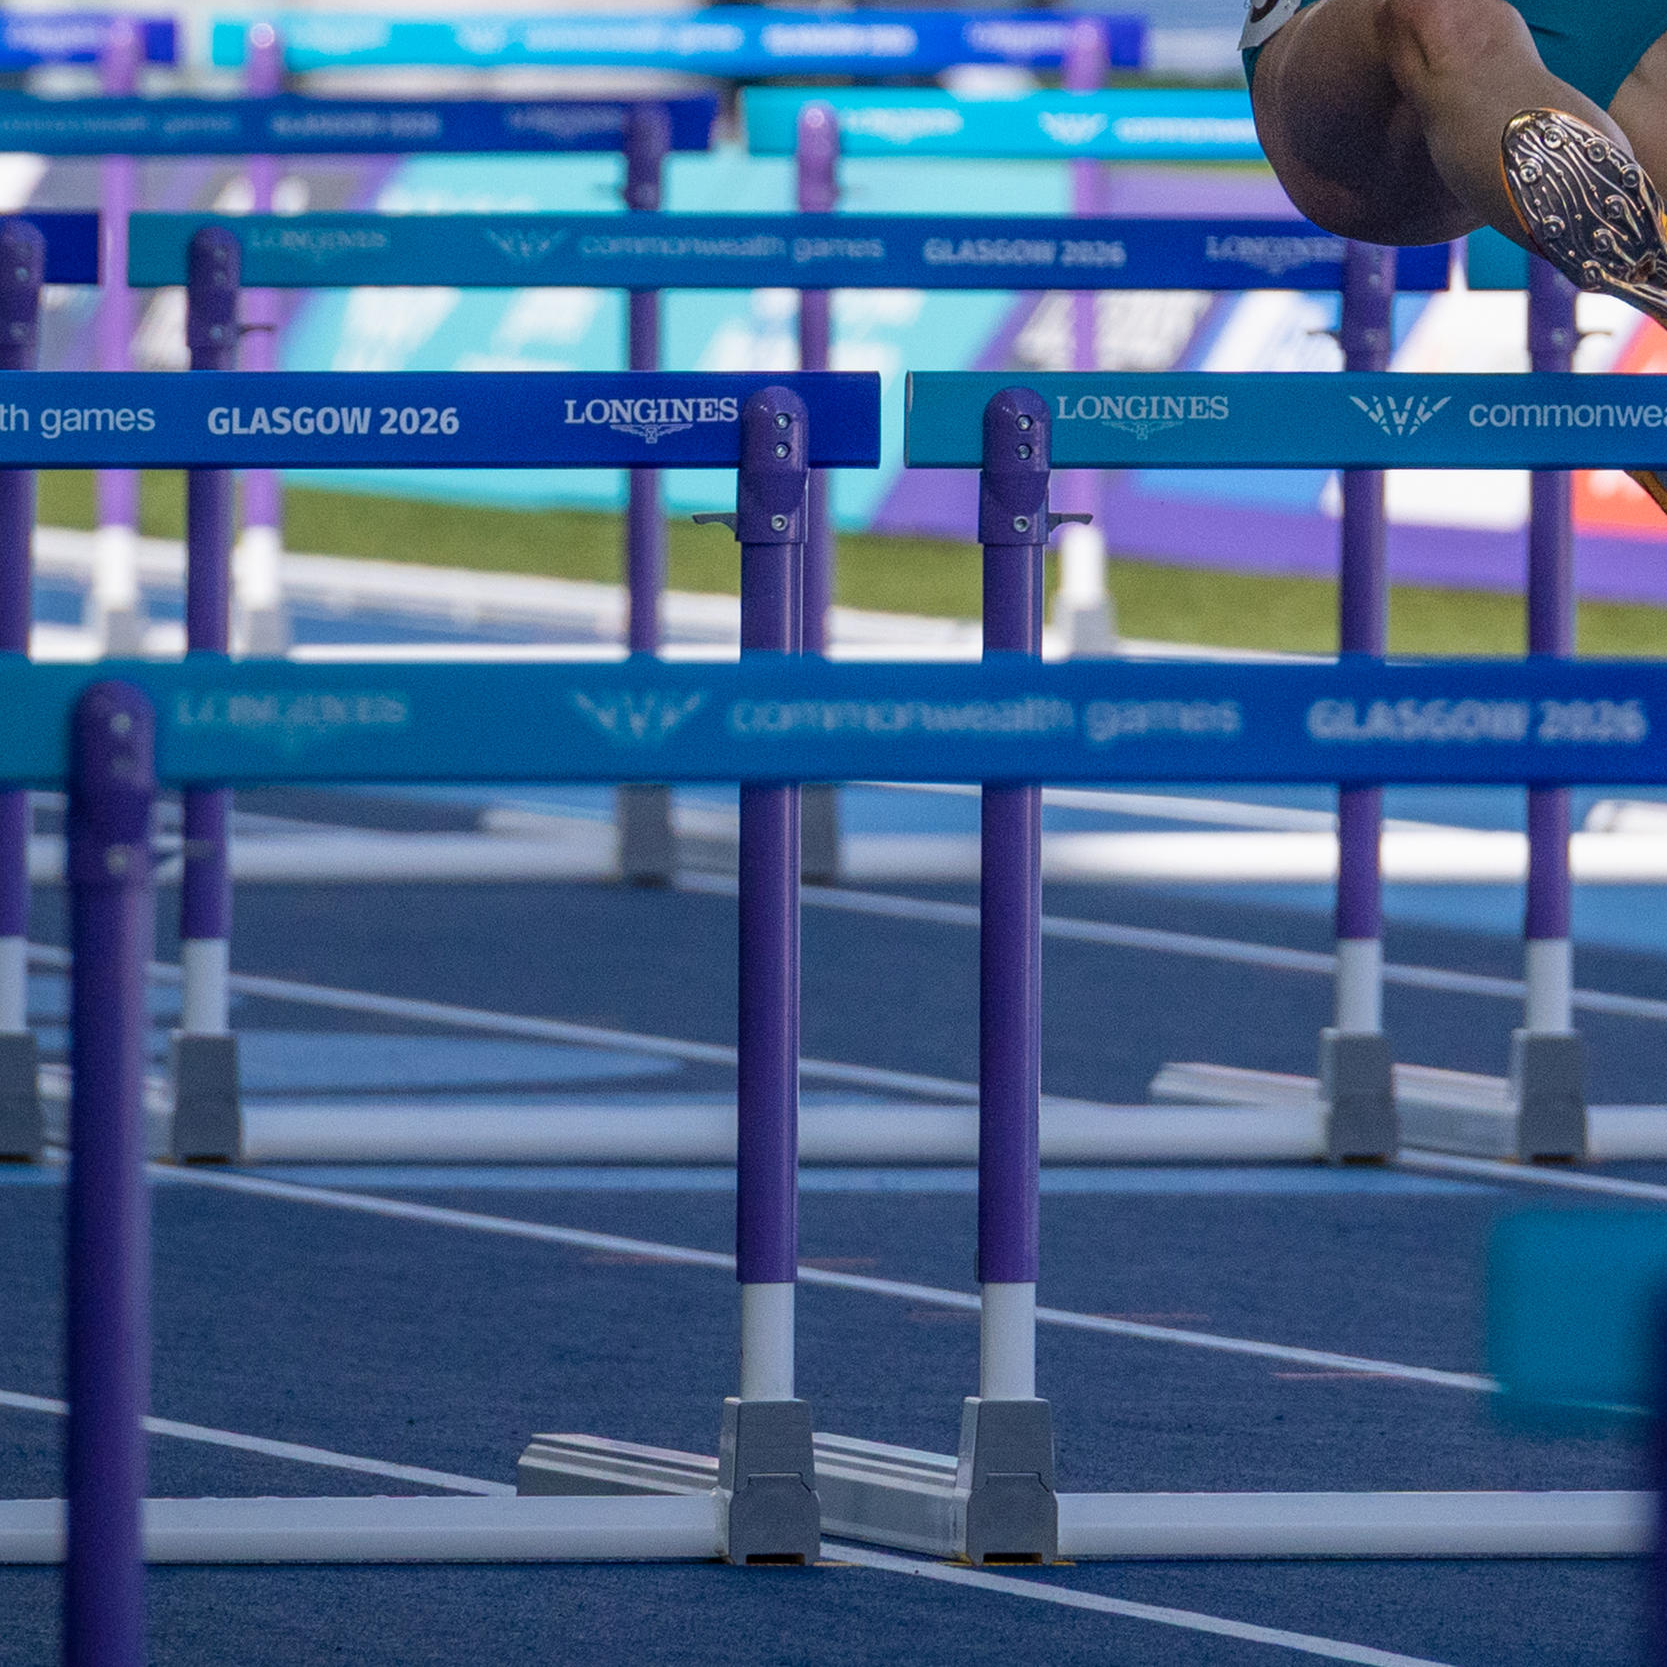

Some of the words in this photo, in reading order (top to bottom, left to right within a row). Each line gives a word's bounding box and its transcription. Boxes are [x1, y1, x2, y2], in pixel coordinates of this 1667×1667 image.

[922, 238, 1055, 267] GLASGOW
[207, 406, 371, 435] GLASGOW
[380, 407, 459, 435] 2026
[564, 397, 739, 424] LONGINES
[1056, 395, 1229, 420] LONGINES
[40, 407, 156, 439] games
